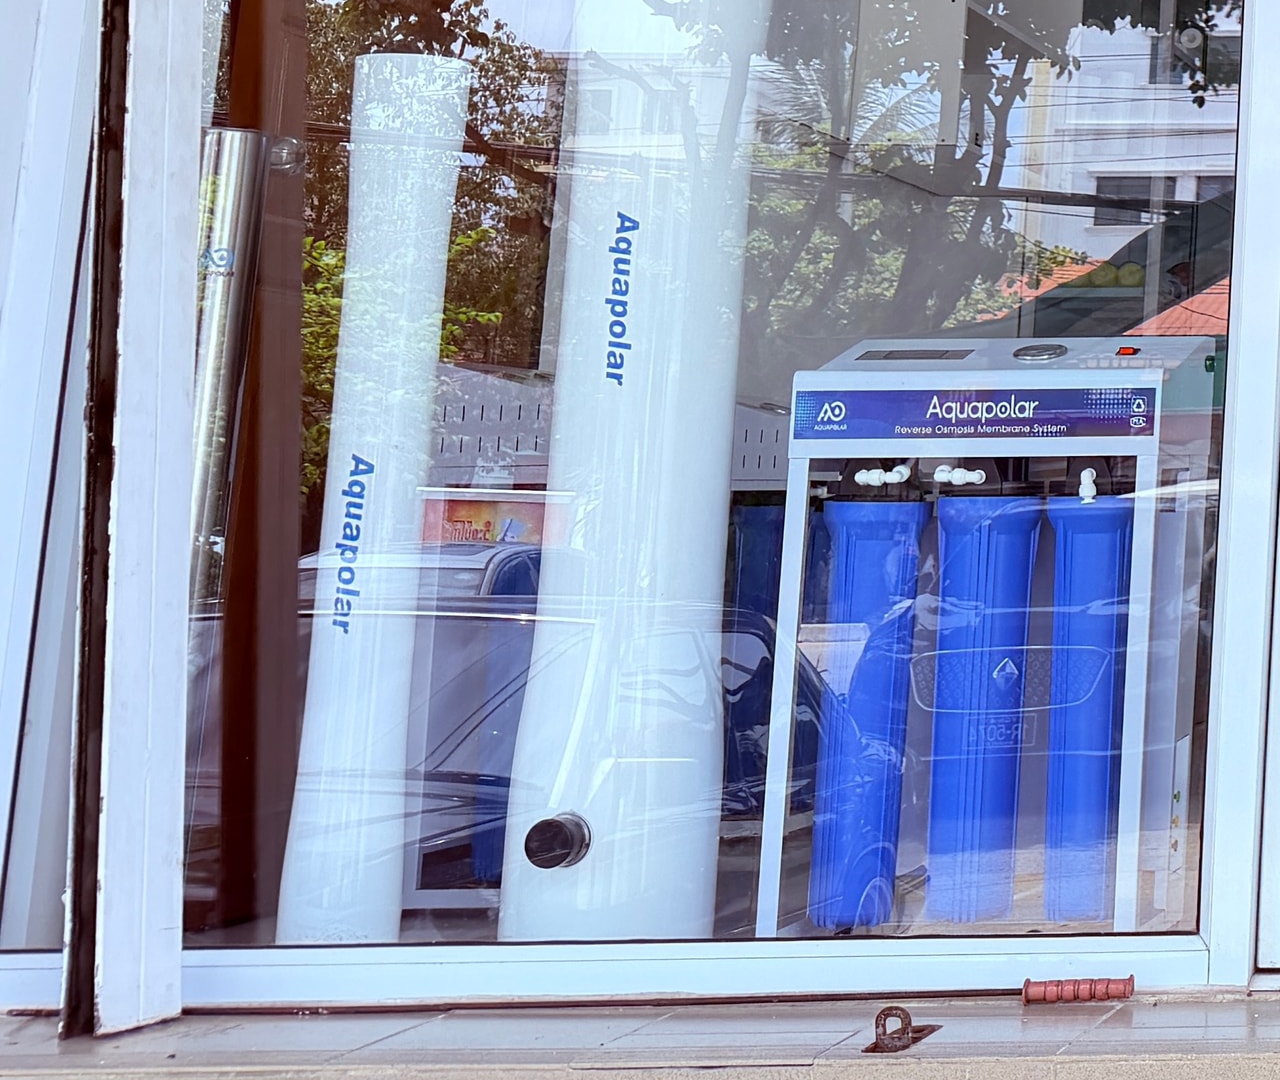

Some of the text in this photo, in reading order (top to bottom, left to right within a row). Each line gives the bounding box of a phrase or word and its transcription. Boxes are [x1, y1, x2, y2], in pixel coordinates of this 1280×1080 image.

[605, 210, 640, 386] Aquapolar
[894, 423, 1067, 435] Reverse Osmosis Membrane System
[926, 394, 1039, 424] Aquapolar
[332, 453, 375, 634] Aquapolar
